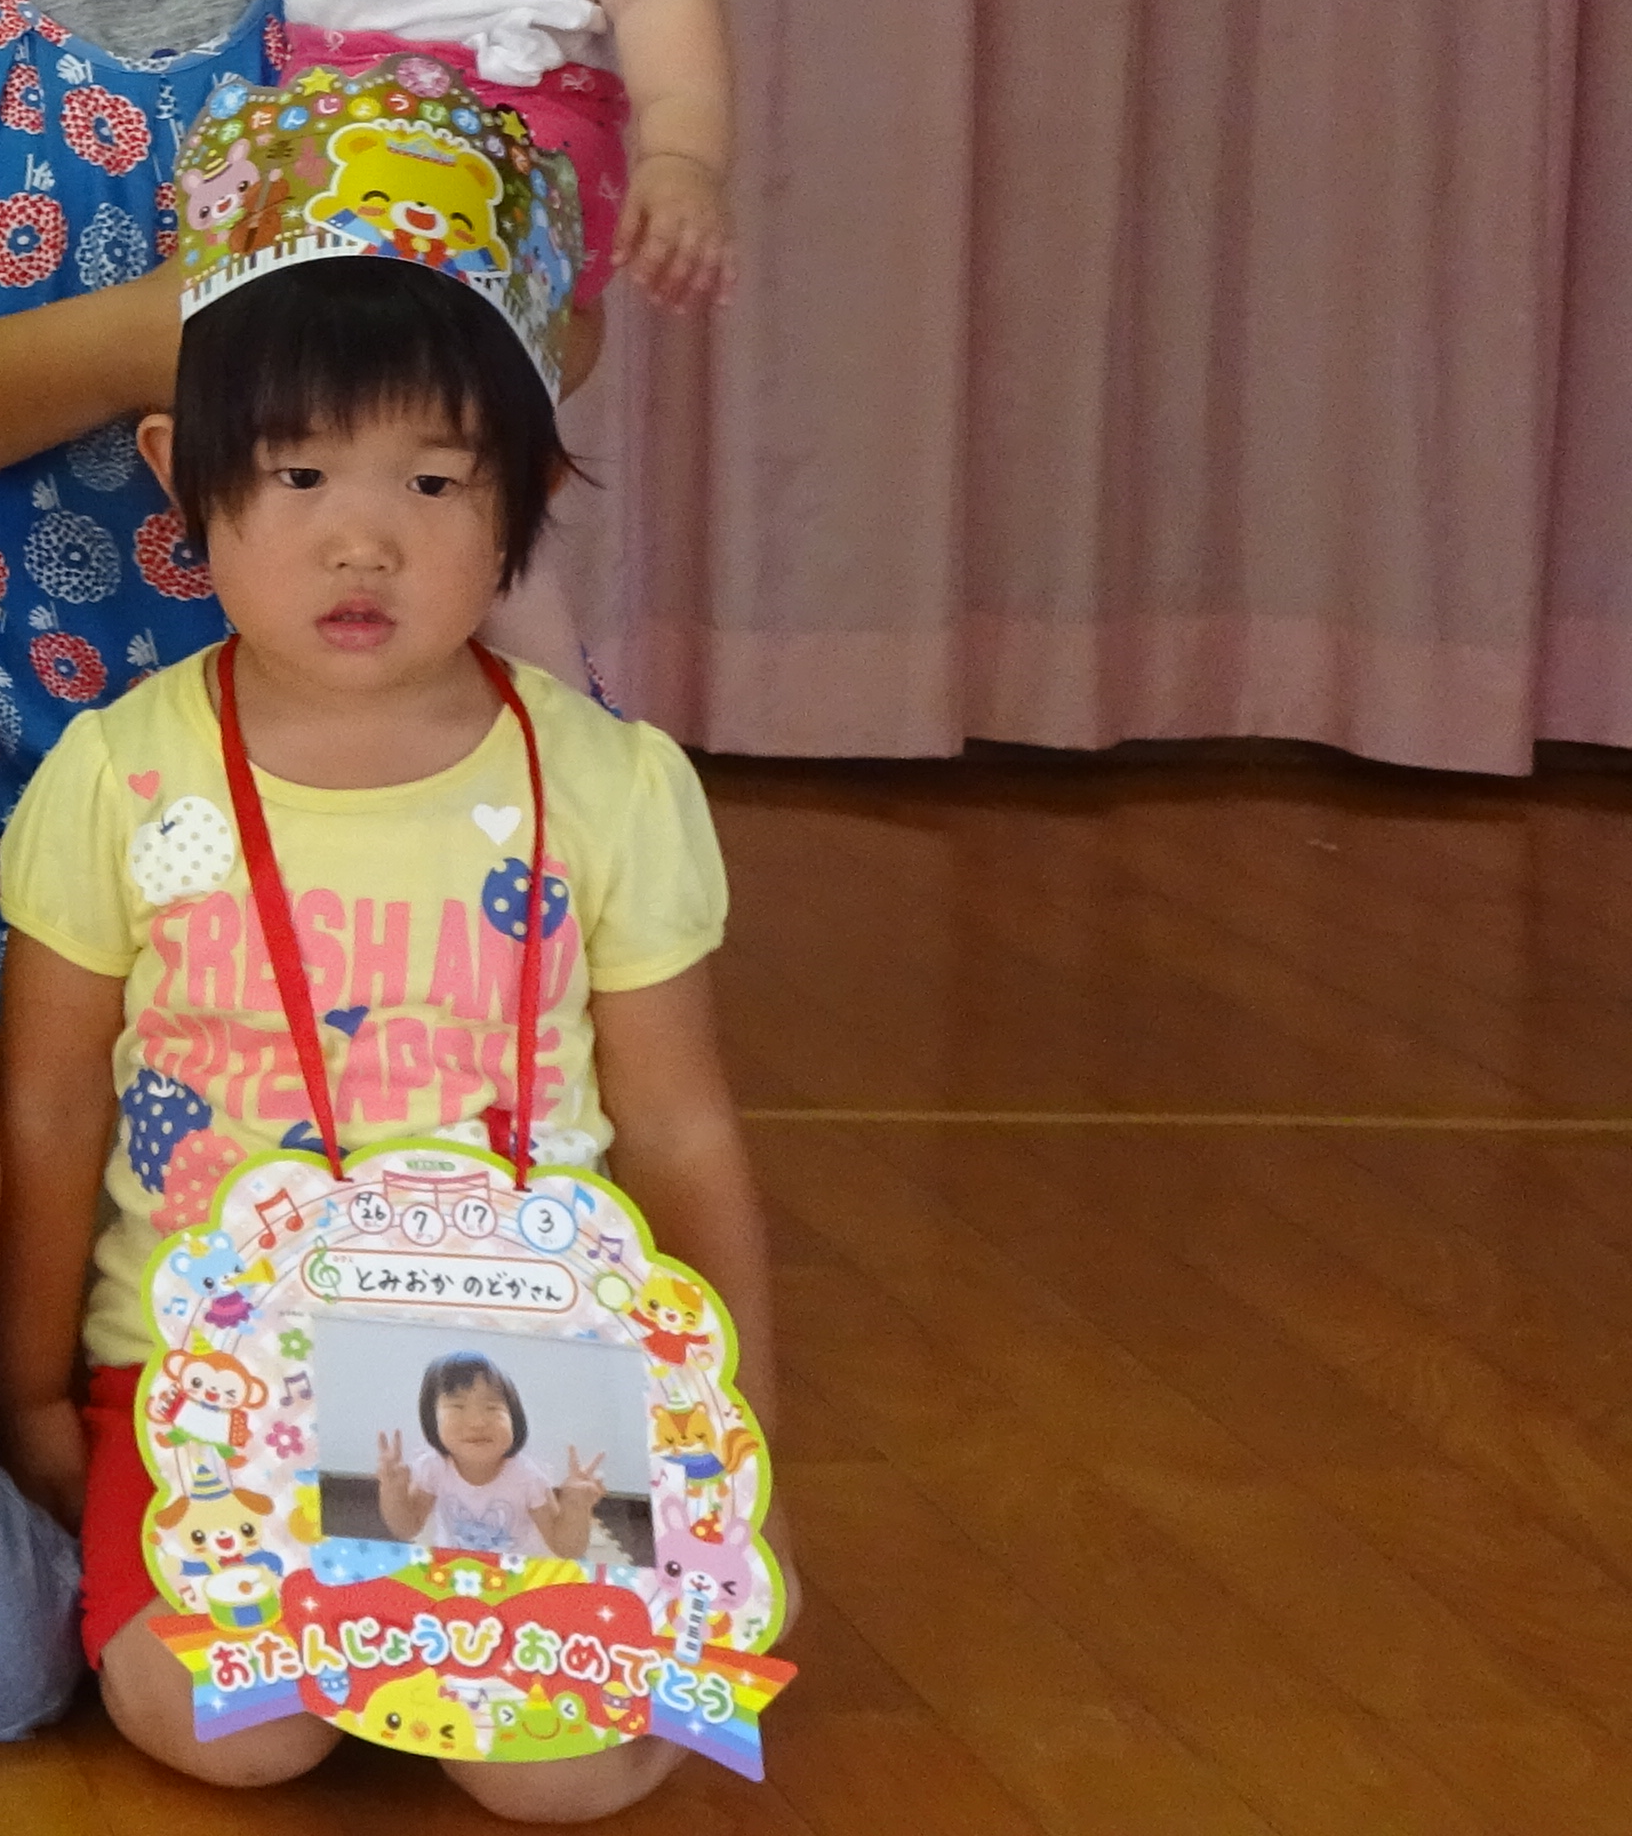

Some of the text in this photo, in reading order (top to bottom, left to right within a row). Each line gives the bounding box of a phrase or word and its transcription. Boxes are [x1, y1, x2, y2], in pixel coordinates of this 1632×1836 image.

[151, 888, 579, 1028] FRESH AND
[411, 1210, 428, 1233] 7
[461, 1203, 488, 1224] 17
[537, 1208, 555, 1234] 3
[355, 1266, 562, 1302] とみおか のどかさん
[206, 1613, 735, 1724] おたんじょうび おめでとう
